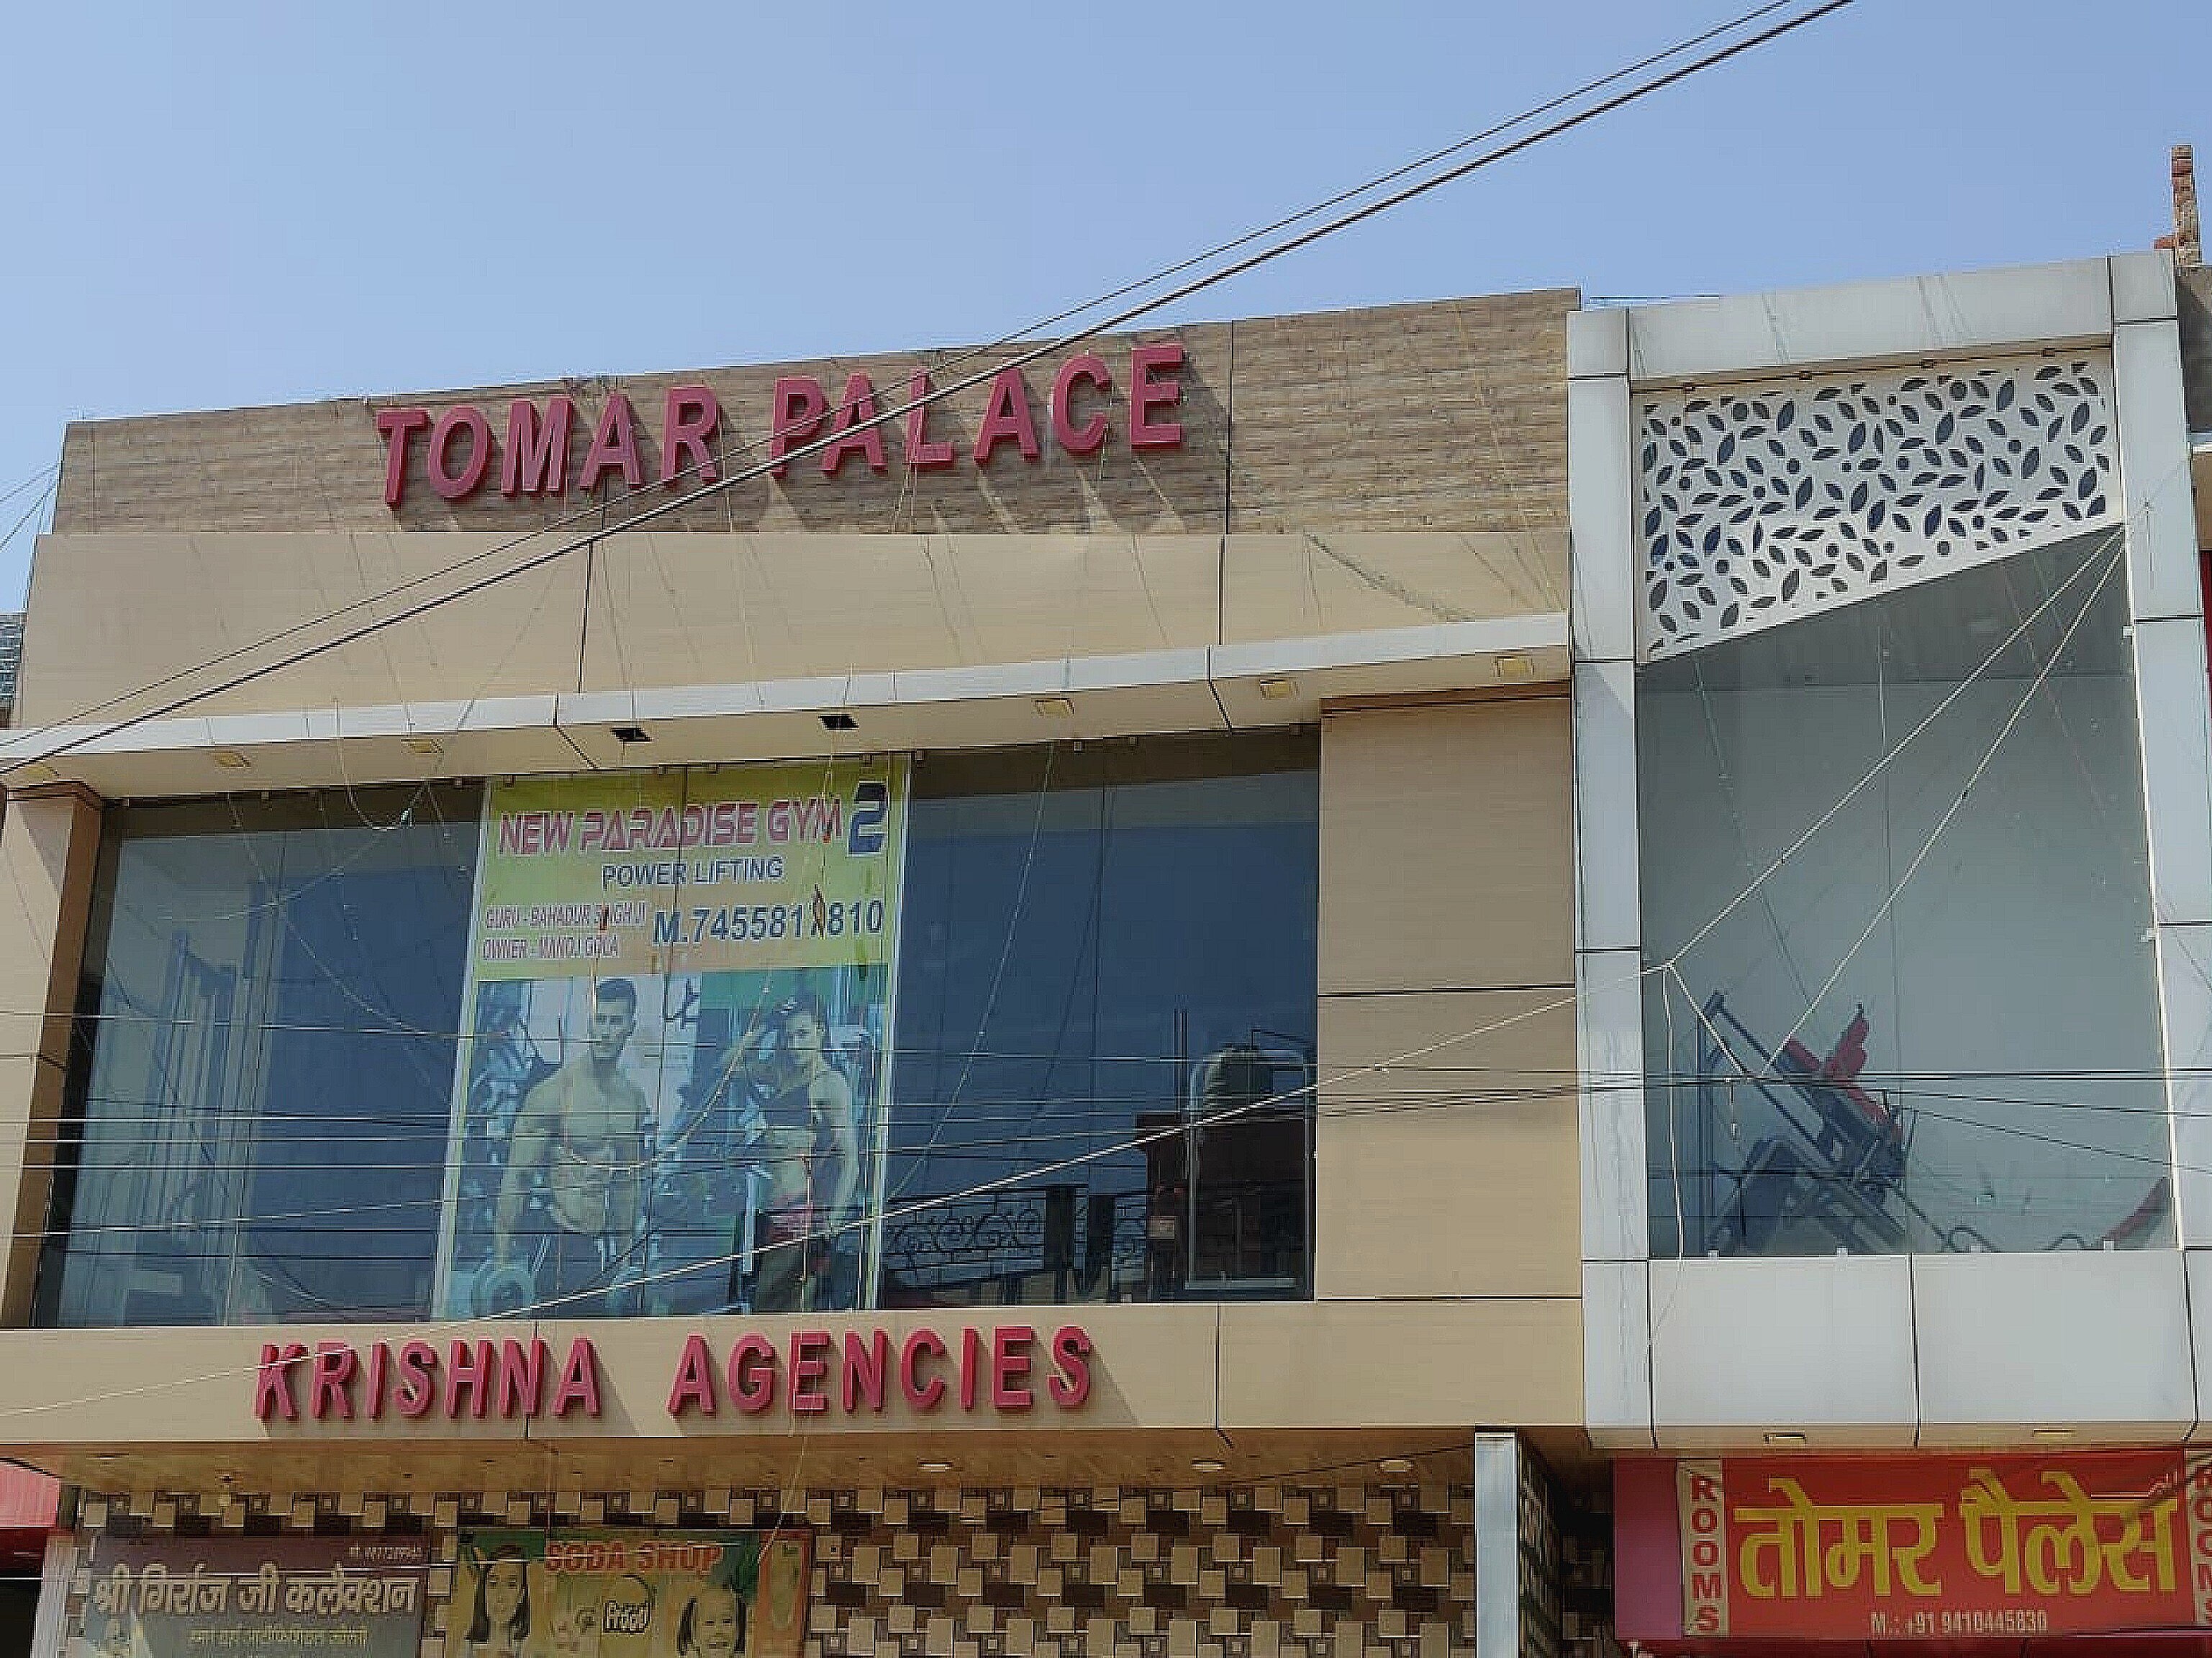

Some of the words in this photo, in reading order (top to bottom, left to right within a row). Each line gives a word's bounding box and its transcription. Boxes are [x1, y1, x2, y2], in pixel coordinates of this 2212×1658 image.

[375, 384, 725, 509] TOMAR
[769, 343, 1187, 481] PALACE
[498, 810, 574, 856] NEW
[580, 800, 760, 852] PARADISE
[767, 796, 842, 843] GYM
[849, 780, 889, 856] 2
[602, 862, 687, 892] POWER
[693, 856, 784, 885] LIFTING
[594, 901, 633, 926] SNGH
[255, 1337, 602, 1421] KRISHNA
[668, 1325, 1092, 1416] AGENCIES
[545, 1540, 625, 1572] SODA
[638, 1539, 724, 1572] SHOP
[1690, 1475, 1721, 1632] ROOMS
[1735, 1478, 1943, 1598] तोमर
[1959, 1467, 2177, 1597] पैलेस
[94, 1562, 130, 1613] श्री
[237, 1560, 279, 1613] जी
